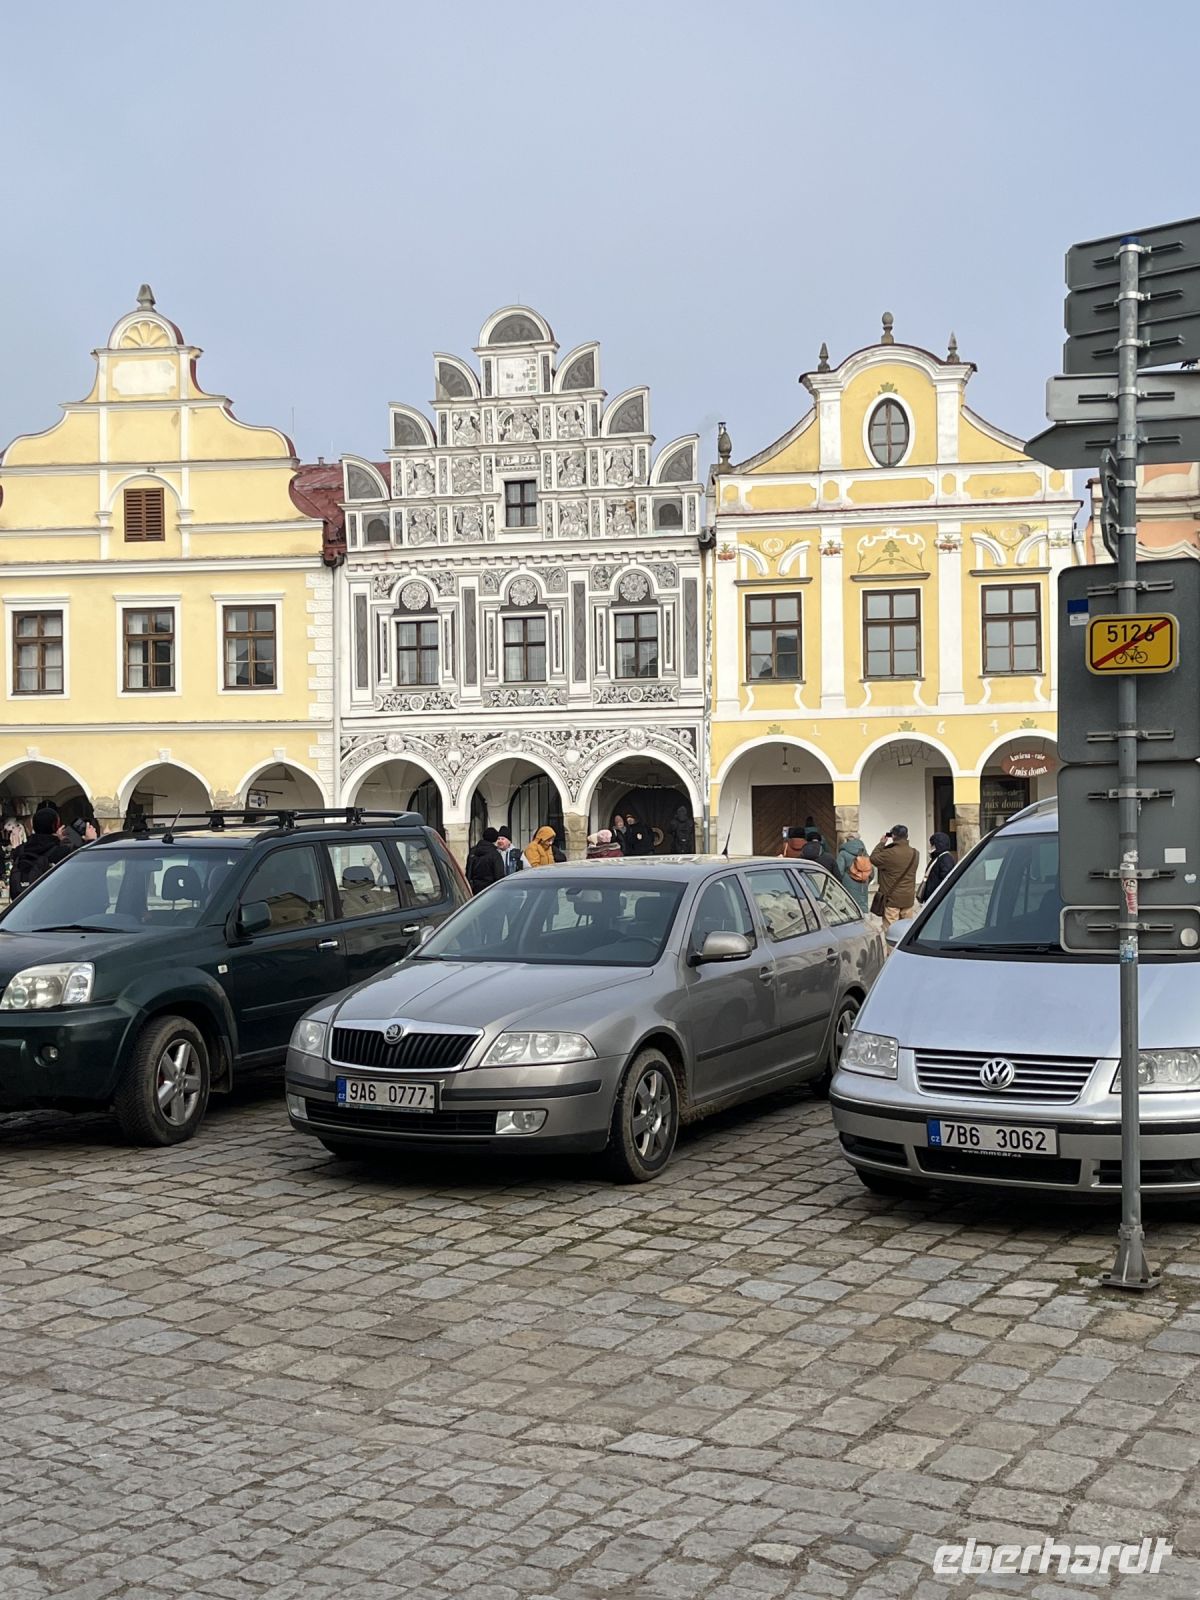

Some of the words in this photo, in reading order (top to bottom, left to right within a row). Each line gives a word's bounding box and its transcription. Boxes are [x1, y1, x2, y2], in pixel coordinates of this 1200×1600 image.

[1107, 623, 1155, 643] 5126
[936, 719, 946, 735] 6
[980, 1057, 1015, 1091] VW
[349, 1082, 377, 1102] 9A6
[388, 1085, 427, 1106] 0777
[930, 1135, 941, 1143] CZ
[944, 1124, 980, 1146] 7B6
[996, 1128, 1047, 1151] 3062
